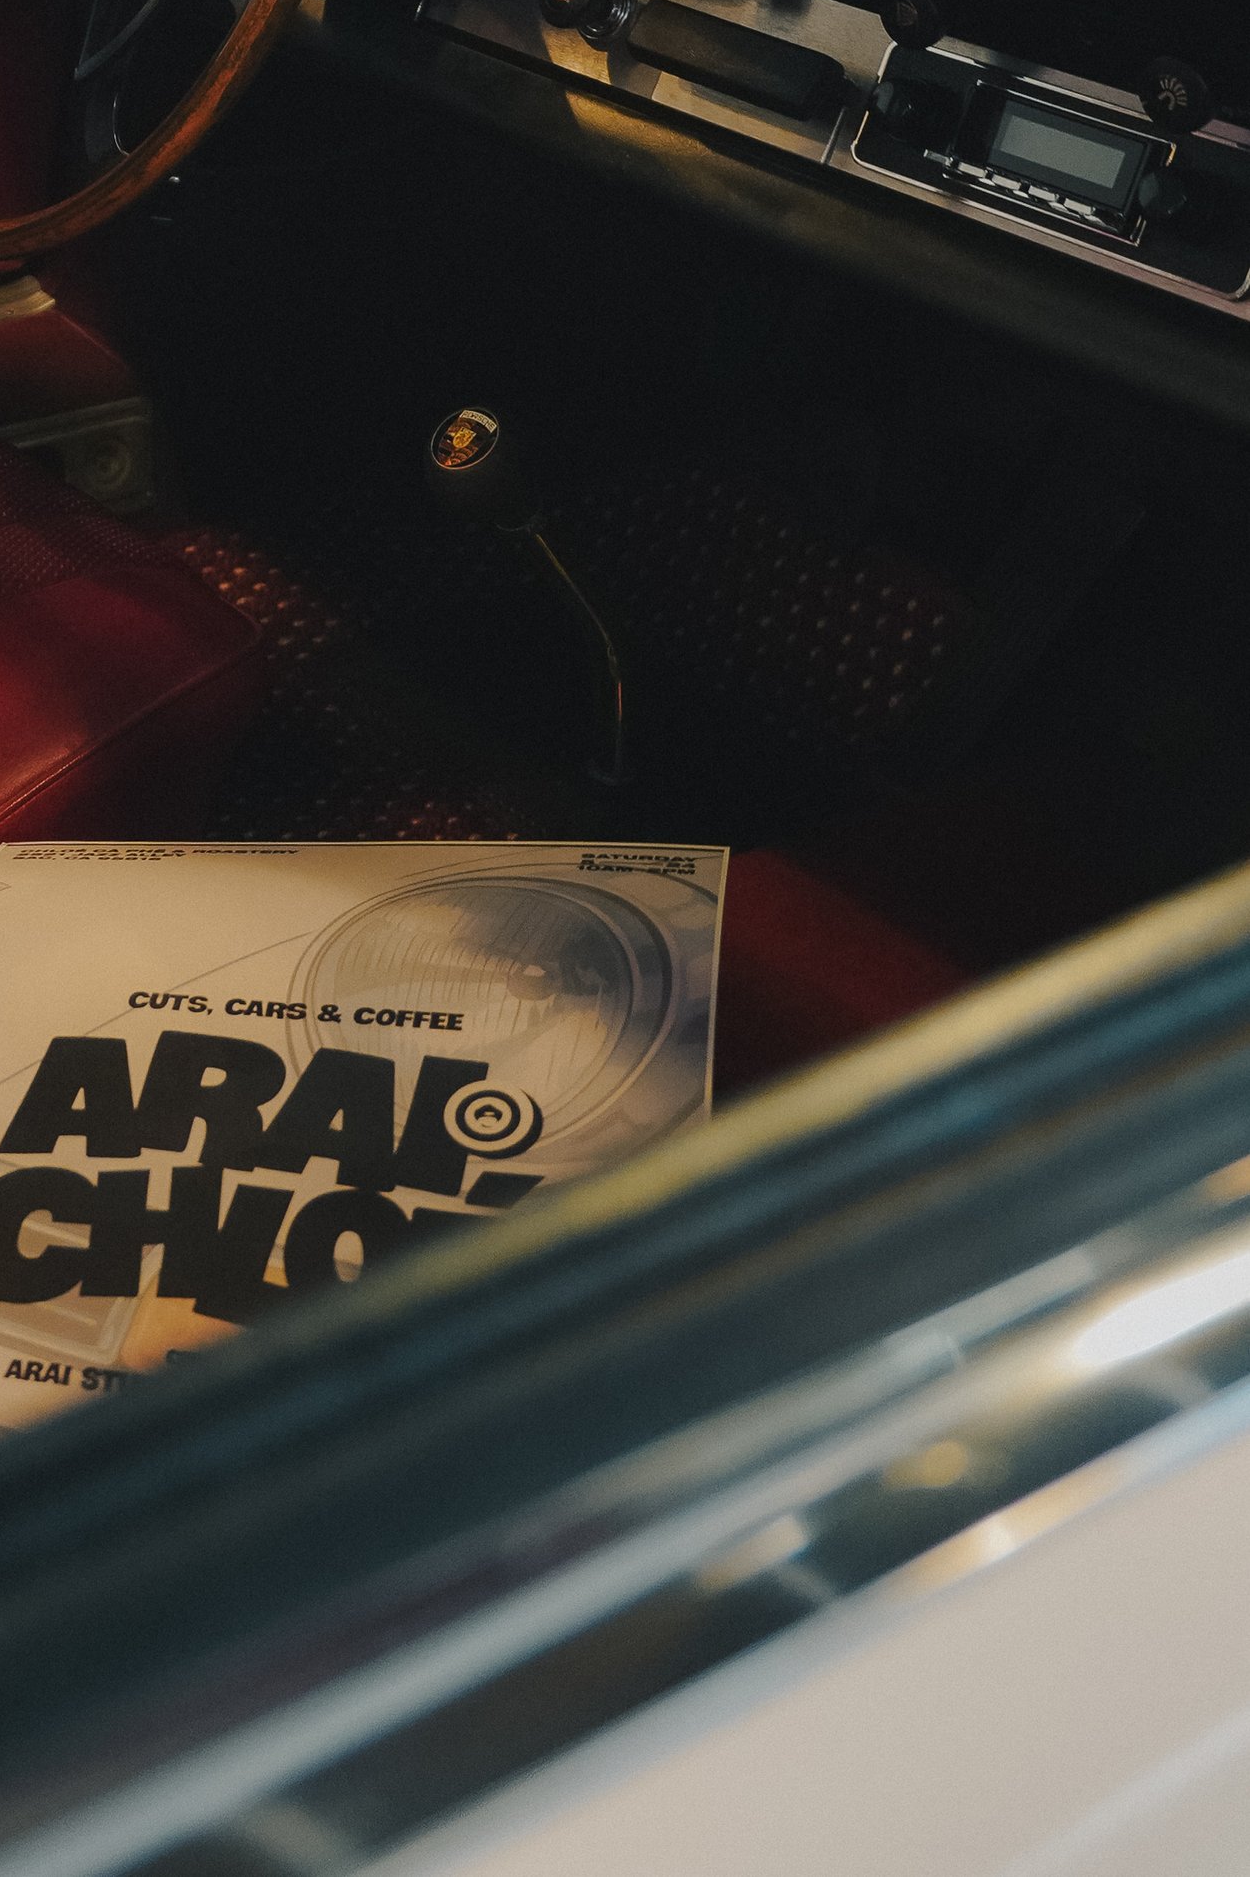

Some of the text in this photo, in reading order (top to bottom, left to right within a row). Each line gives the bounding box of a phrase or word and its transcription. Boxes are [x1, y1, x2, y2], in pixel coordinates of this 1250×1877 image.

[582, 853, 696, 862] SATURDAY
[127, 990, 465, 1032] CUTS, CARS & COFFEE
[4, 1358, 75, 1386] ARAI
